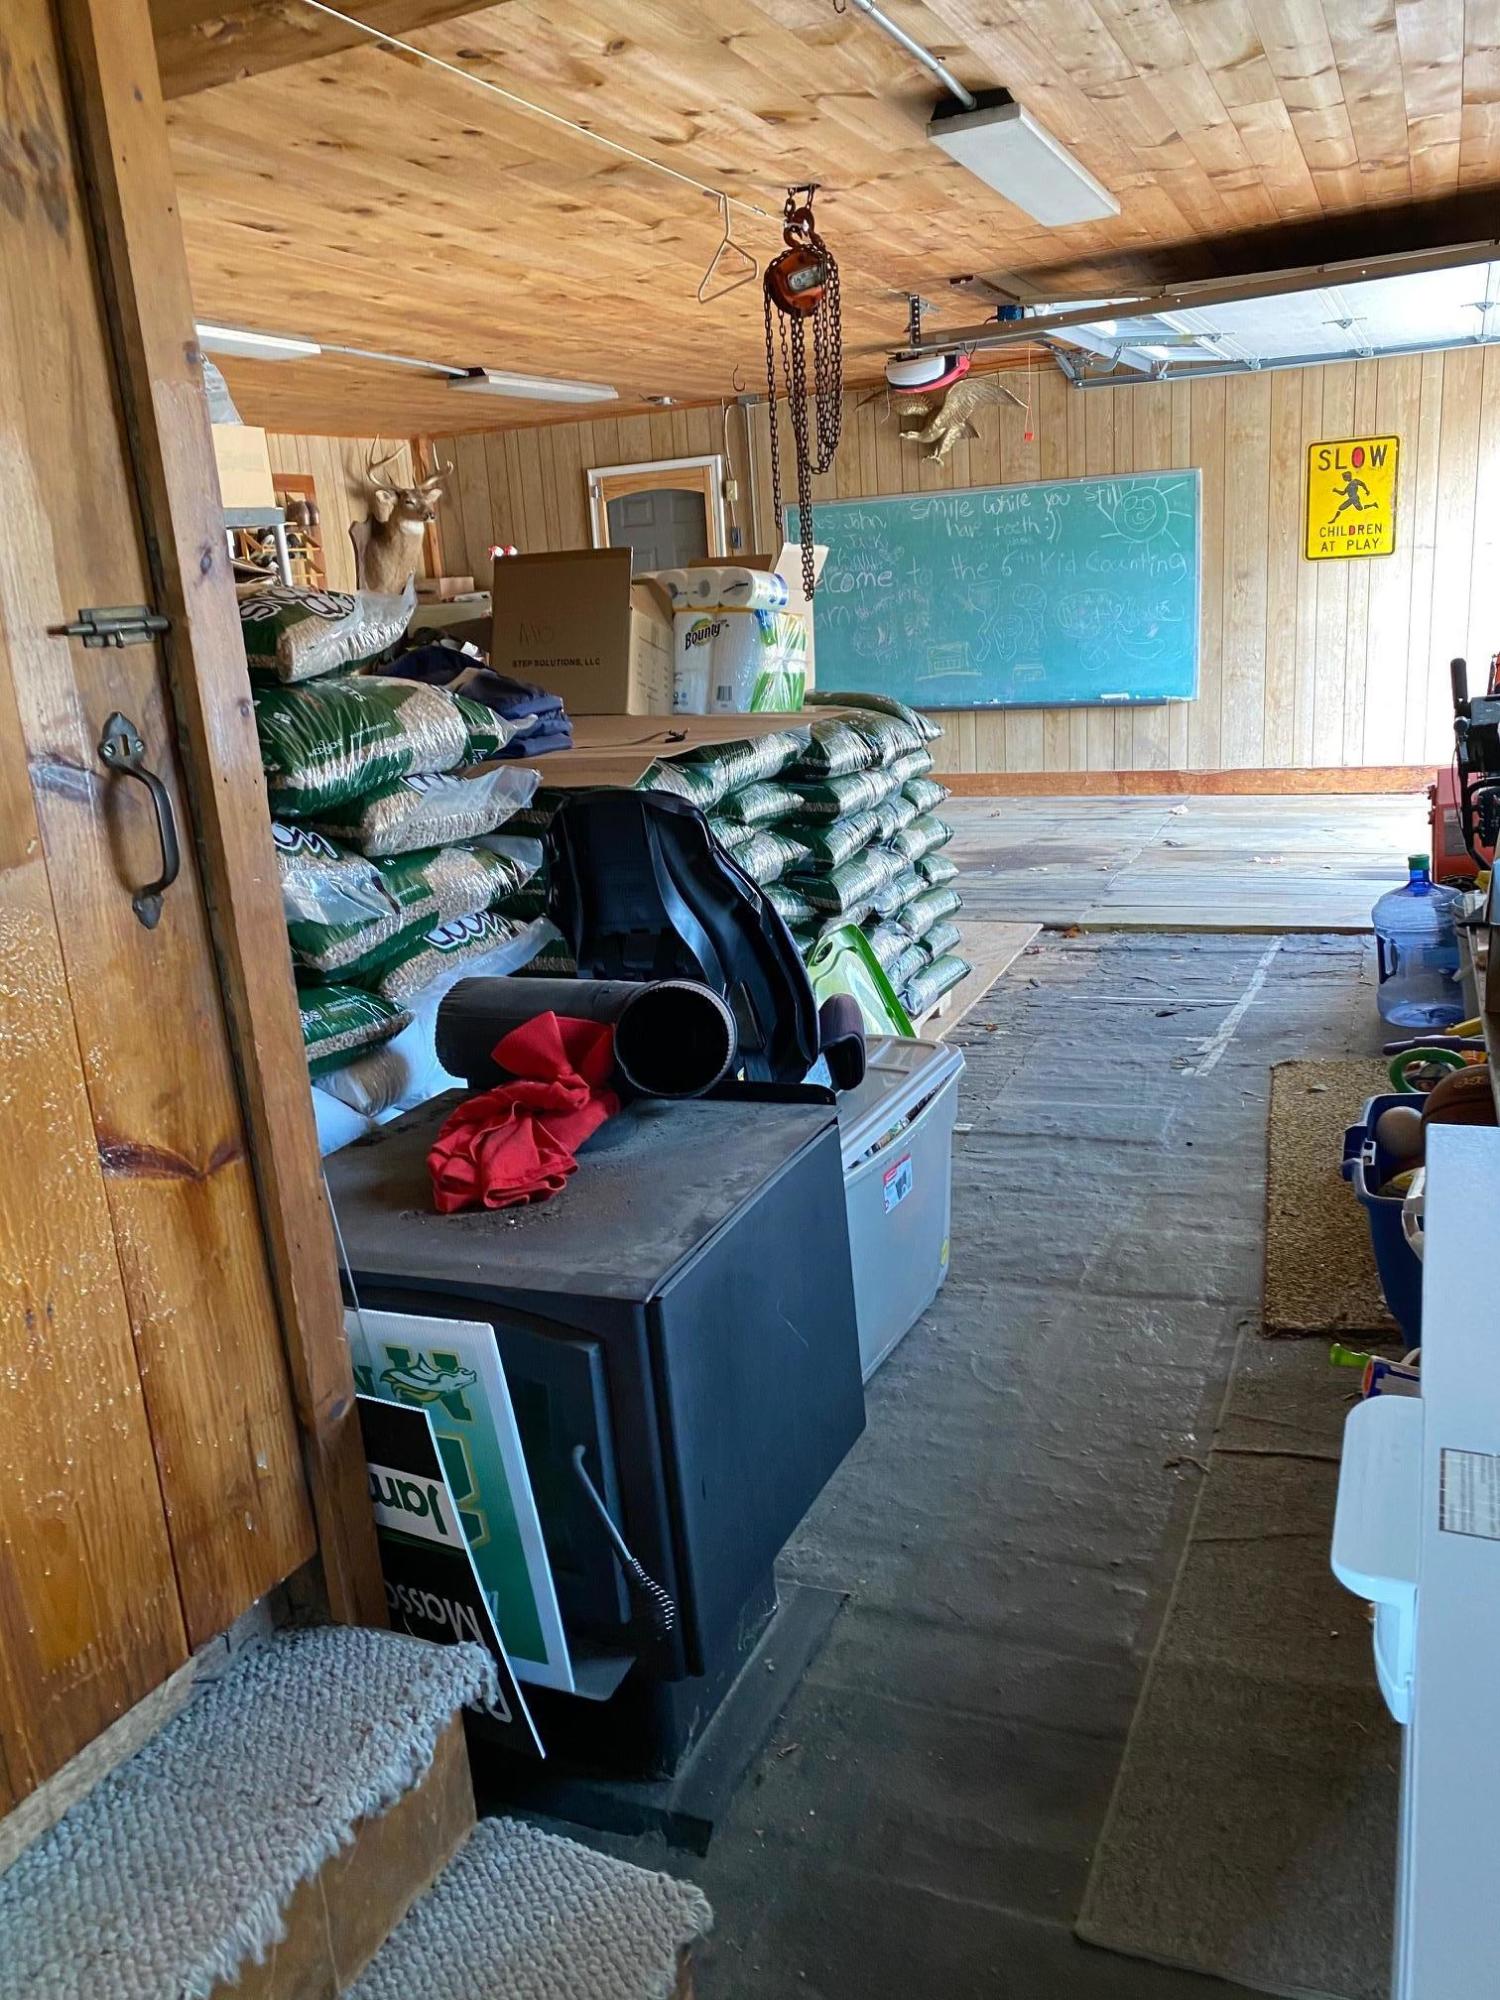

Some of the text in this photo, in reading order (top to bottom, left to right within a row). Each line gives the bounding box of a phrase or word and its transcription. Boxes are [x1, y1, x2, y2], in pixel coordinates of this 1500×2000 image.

[1318, 444, 1388, 471] SLOW
[1319, 523, 1383, 538] CHILDREN
[1321, 538, 1380, 553] AT PLAY
[814, 568, 893, 595] elcome
[947, 552, 989, 580] the
[685, 623, 721, 651] Bounty
[512, 657, 600, 668] STEP SOLUTIONS, LLC
